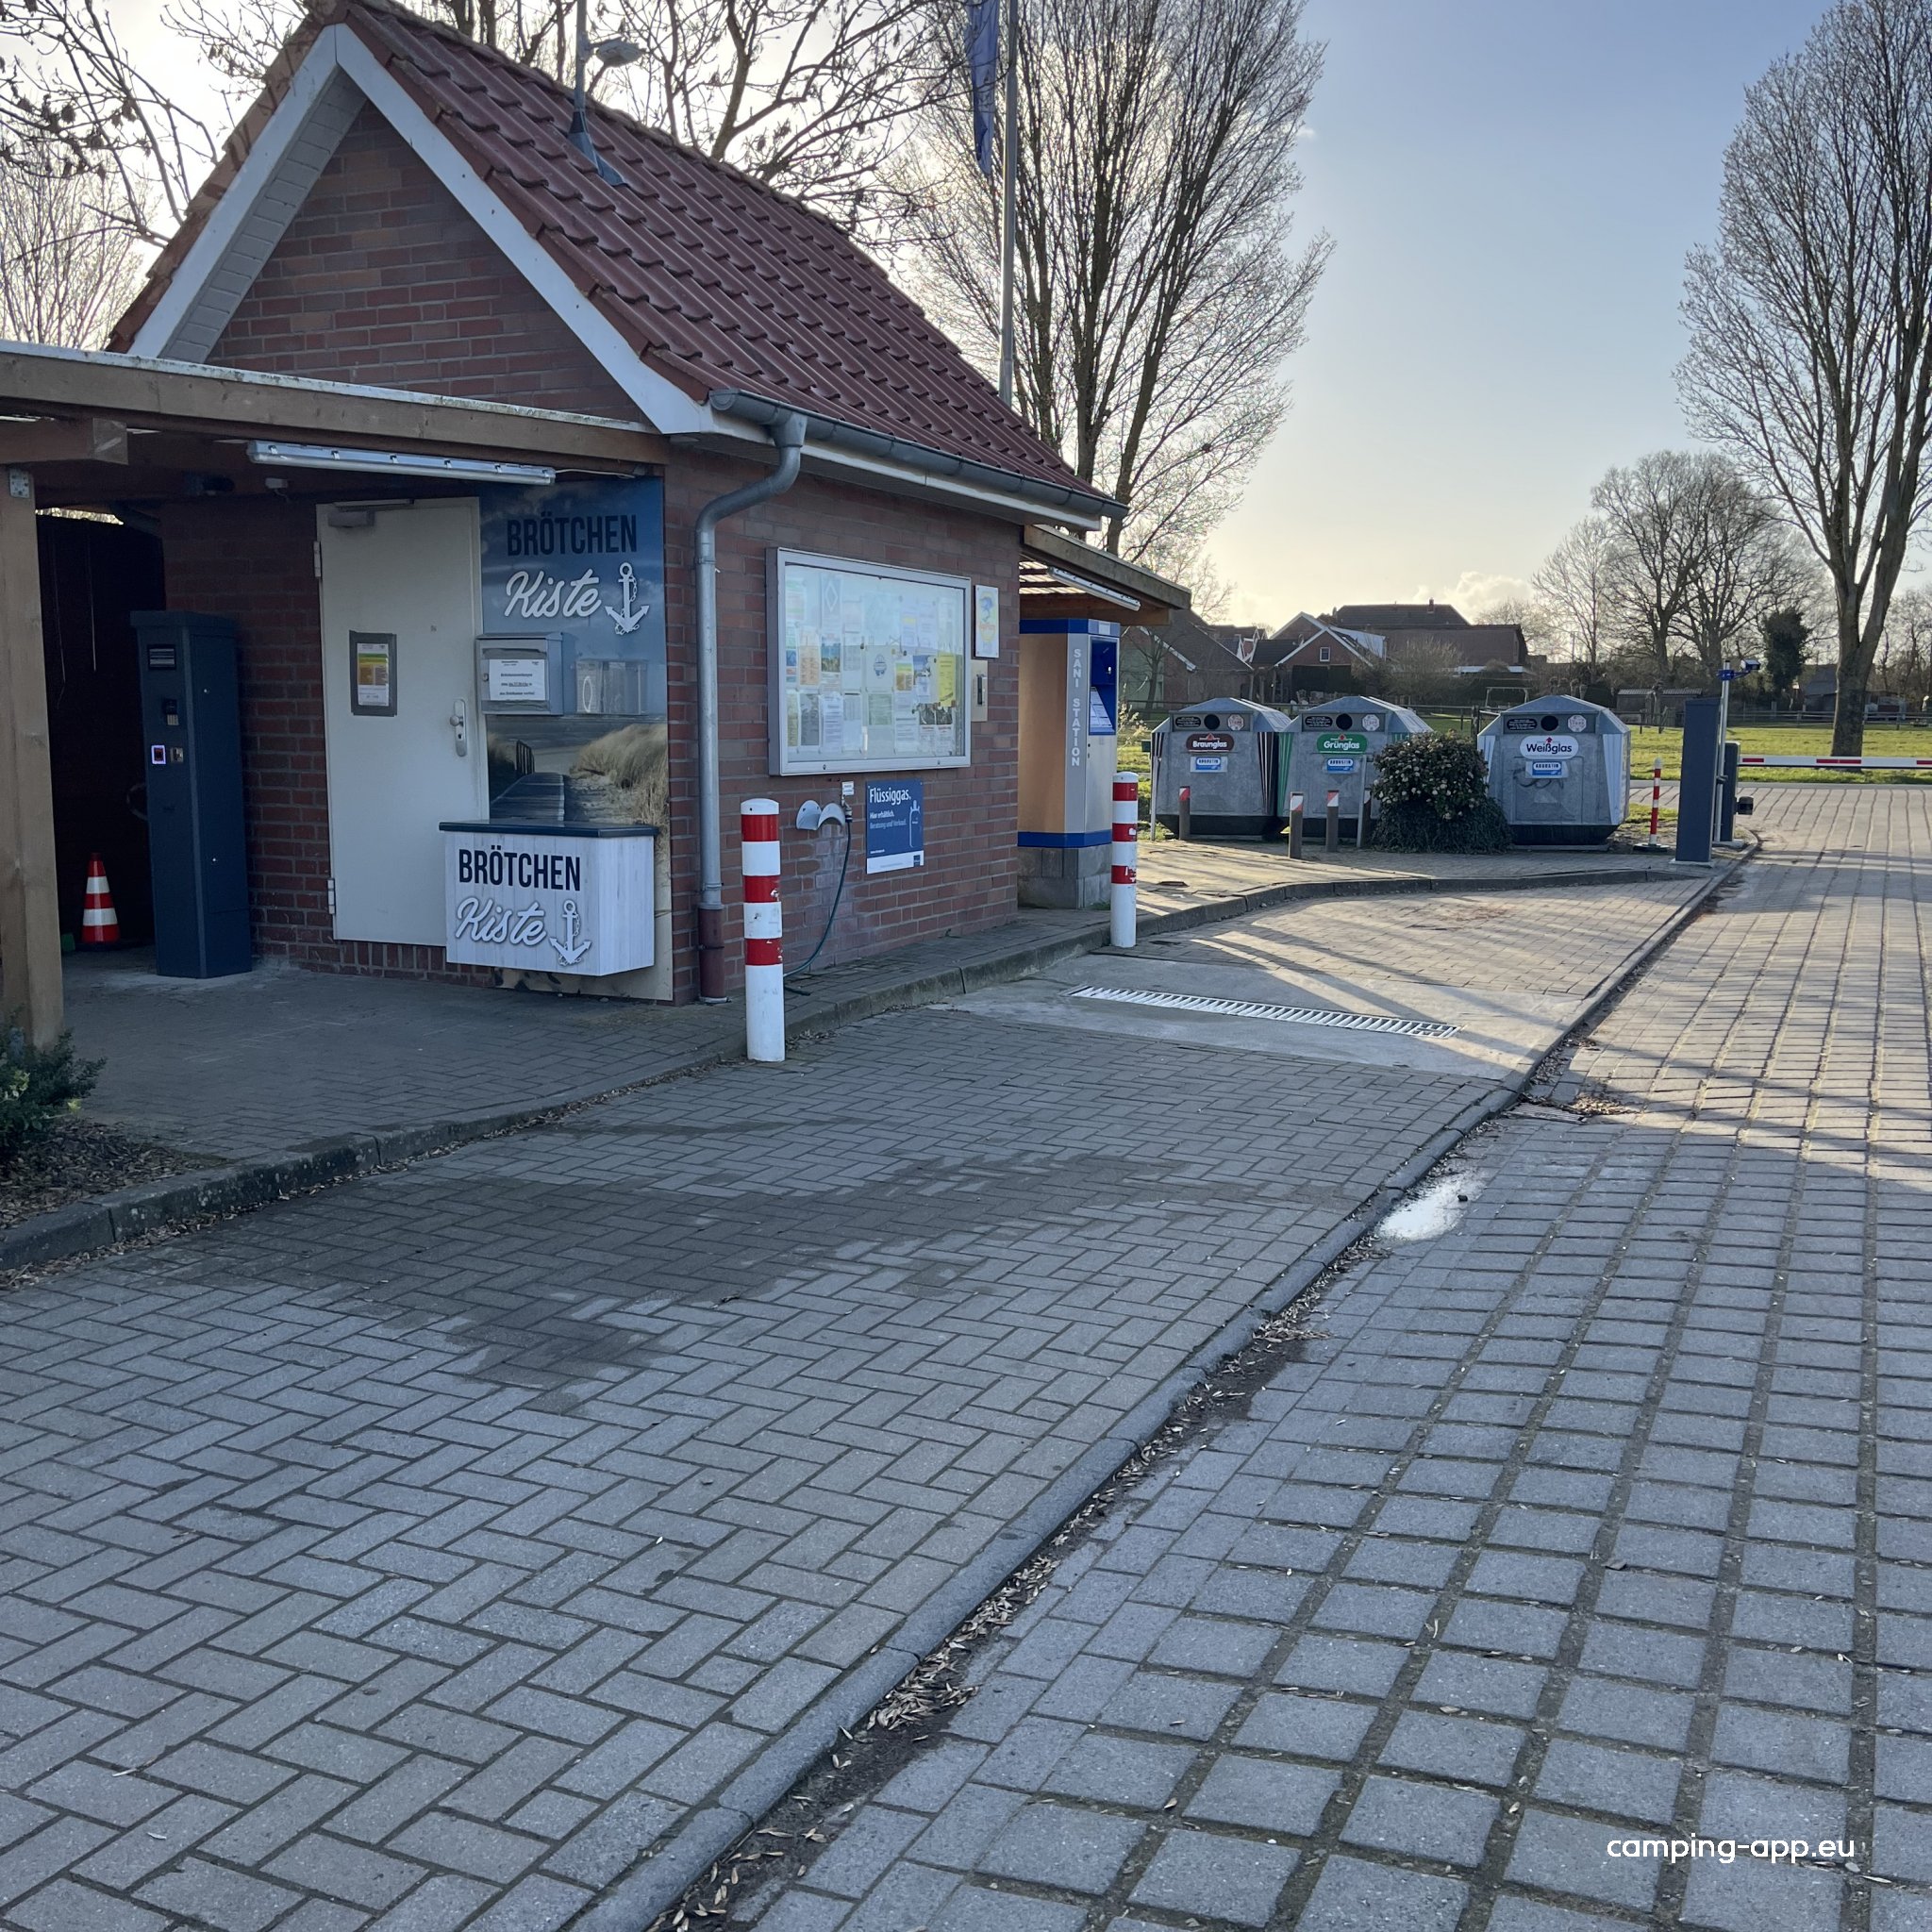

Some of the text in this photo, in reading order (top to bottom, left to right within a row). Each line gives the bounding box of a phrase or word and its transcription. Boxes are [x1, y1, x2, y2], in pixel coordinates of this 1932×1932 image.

[507, 511, 638, 557] BRÖTCHEN
[504, 568, 602, 618] Kiste
[1071, 649, 1082, 766] SANI STATION
[1192, 741, 1227, 749] Braunglas
[1324, 741, 1360, 750] Grünglas
[1526, 744, 1572, 754] Weißglas
[869, 788, 911, 805] Flüssiggas.
[458, 844, 581, 891] BRÖTCHEN
[455, 897, 547, 946] Kiste
